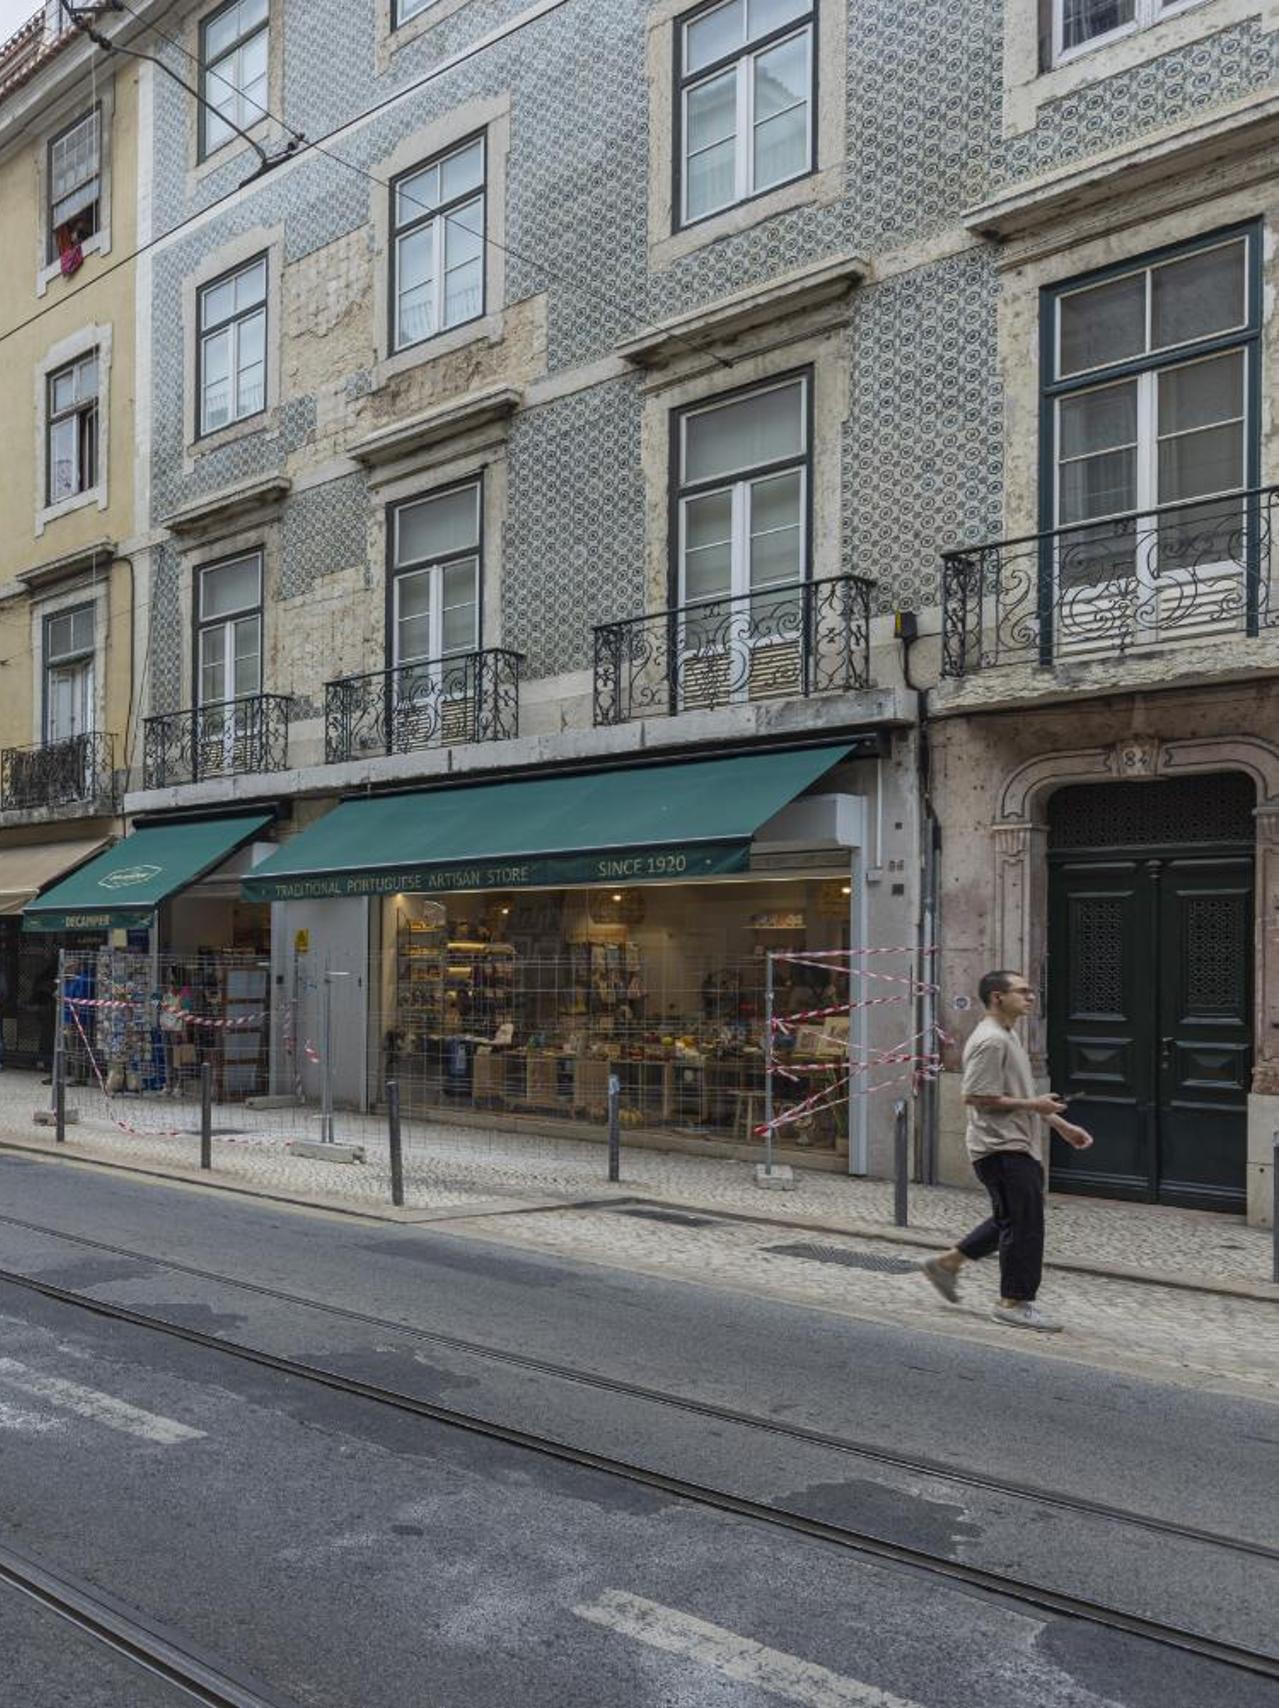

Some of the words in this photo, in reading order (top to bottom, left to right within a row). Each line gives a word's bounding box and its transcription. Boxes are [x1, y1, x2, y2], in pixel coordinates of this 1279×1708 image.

[599, 858, 642, 876] SINCE
[647, 855, 686, 873] 1920
[275, 883, 341, 898] TRADITIONAL
[347, 874, 421, 892] PORTUGUESE
[428, 870, 480, 888] ARTISAN
[487, 867, 529, 885] STORE
